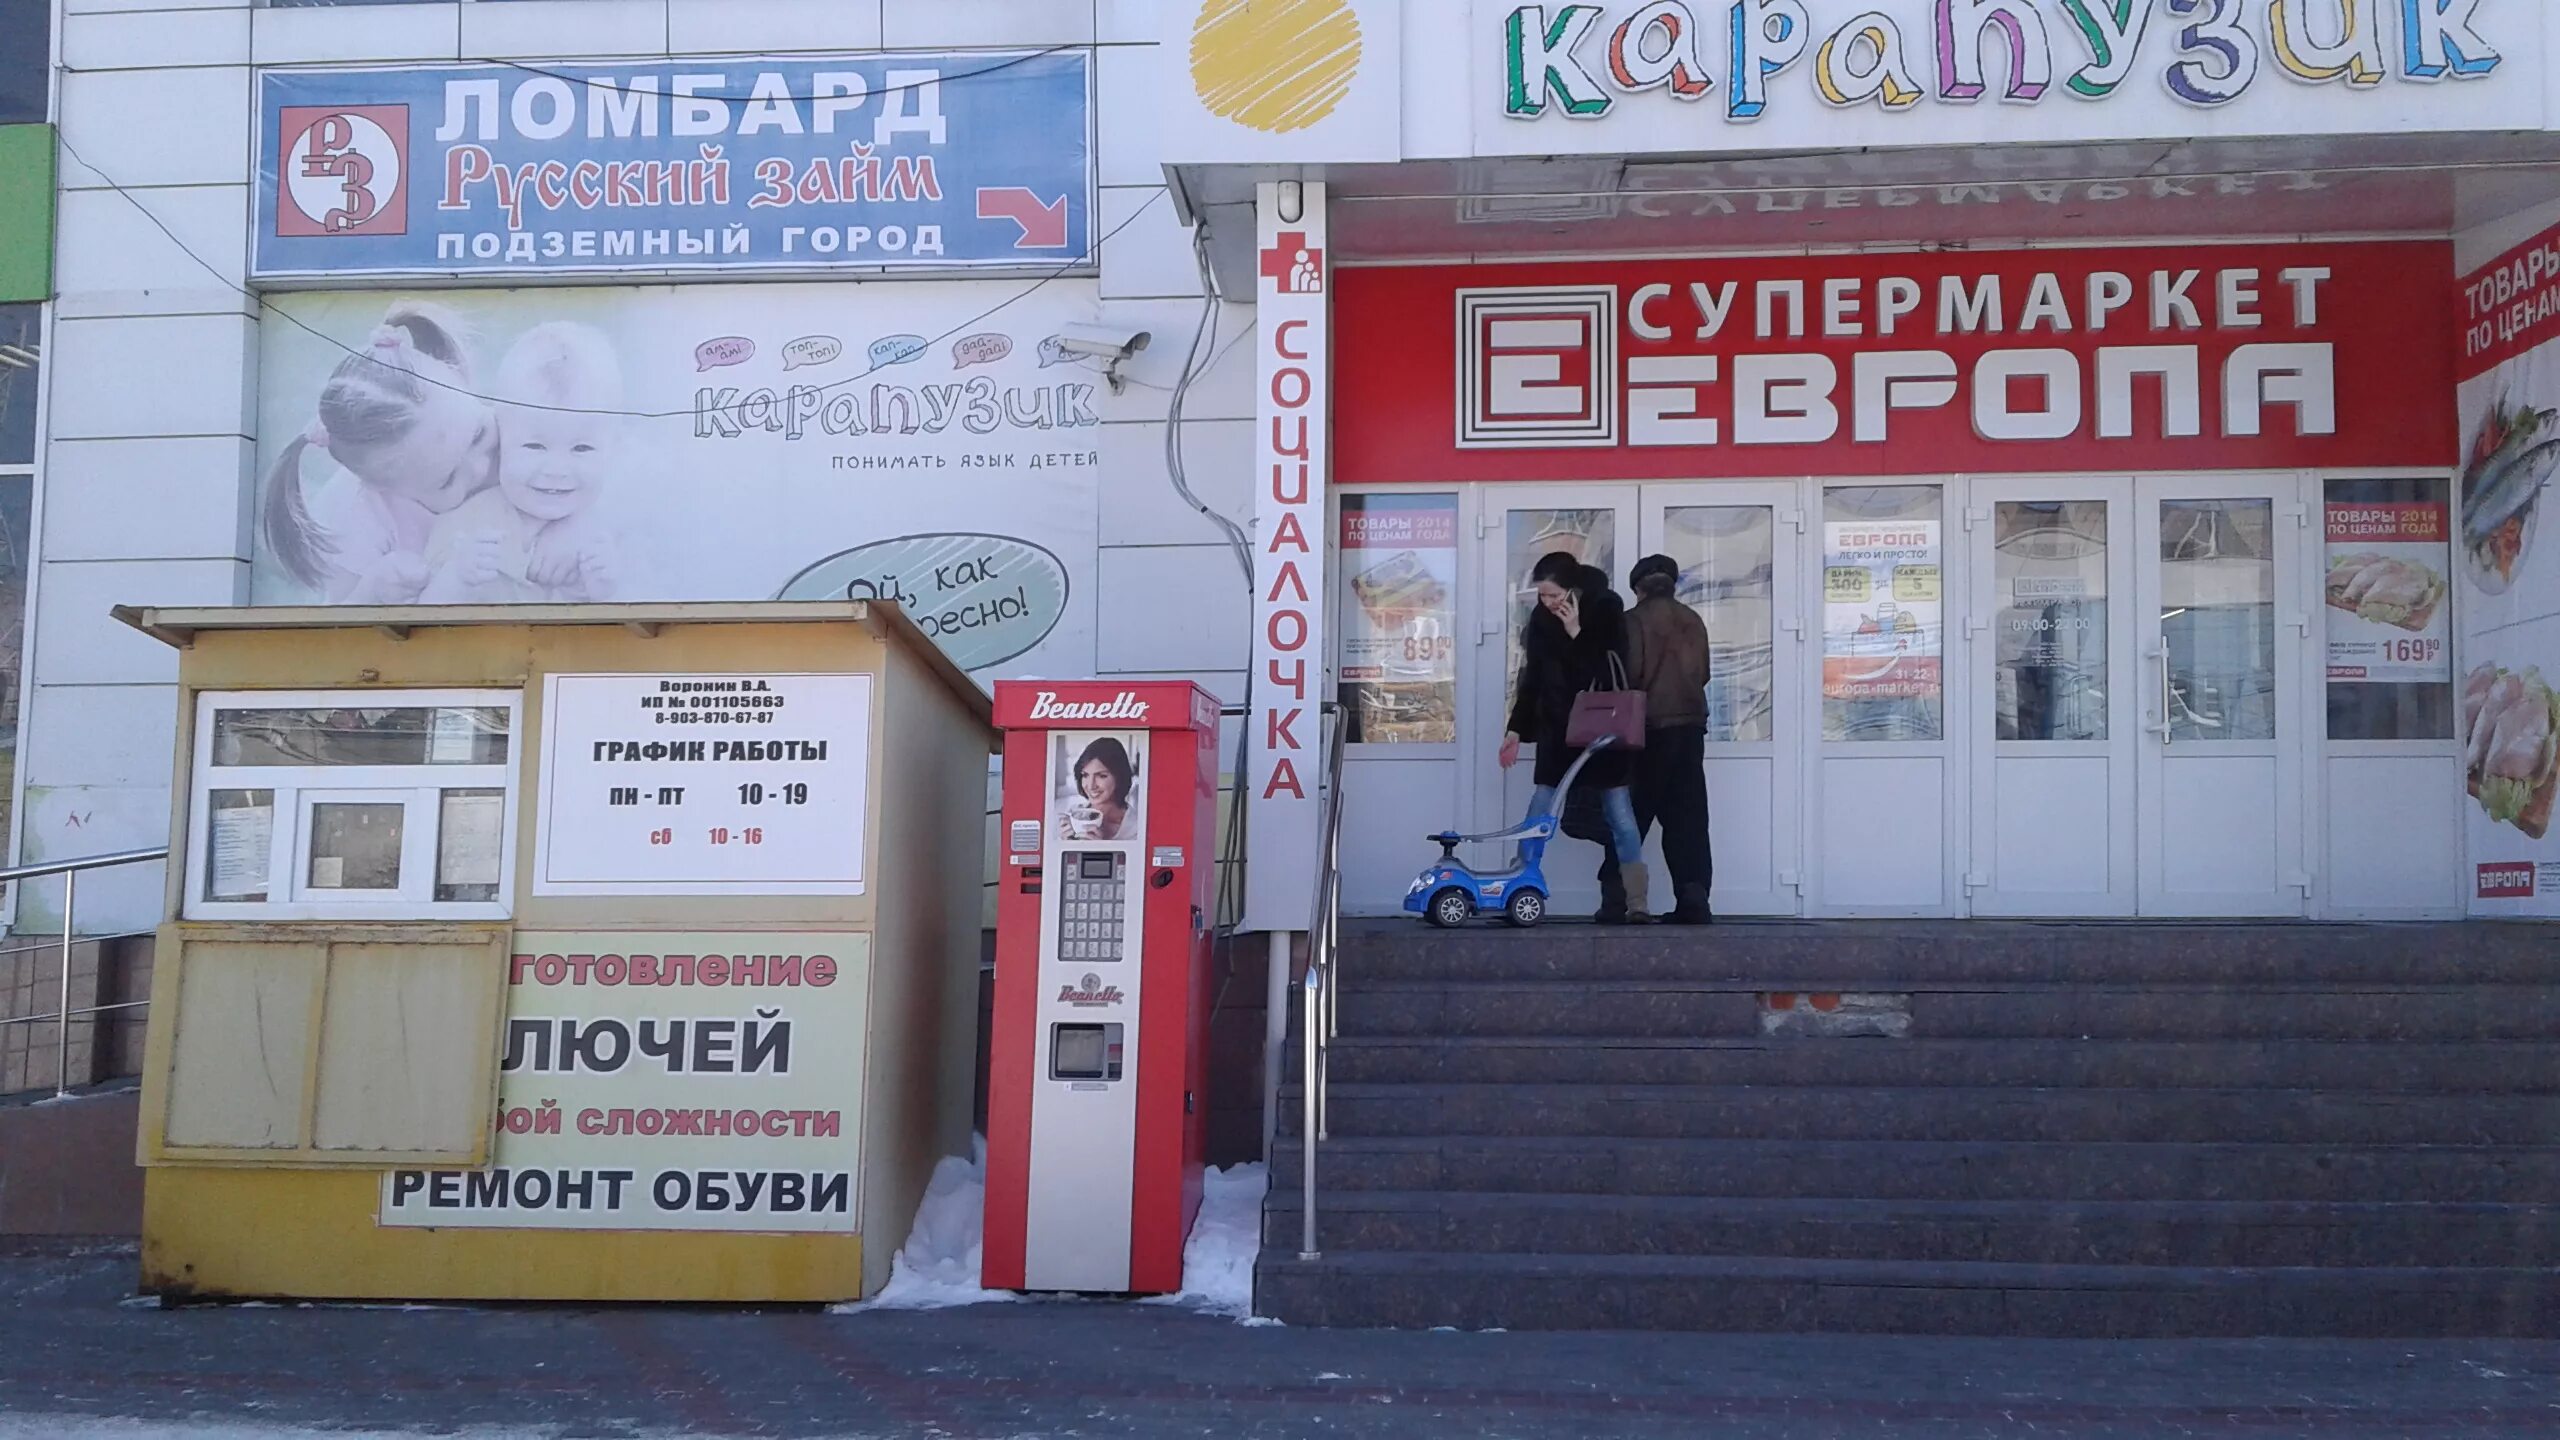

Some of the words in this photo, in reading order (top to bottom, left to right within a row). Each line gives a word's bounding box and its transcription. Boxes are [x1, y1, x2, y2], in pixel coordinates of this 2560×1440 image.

[436, 69, 947, 145] ЛОМБАРД
[438, 142, 731, 230] Русский
[746, 141, 944, 209] займ
[436, 224, 750, 261] ПОДЗЕМНЫЙ
[781, 225, 945, 255] ГОРОД
[1628, 267, 2331, 341] СУПЕРМАРКЕТ
[2467, 320, 2492, 357] ПО
[1628, 342, 2335, 446] ЕВРОПА
[832, 456, 946, 470] ПОНИМАТЬ
[961, 454, 1015, 468] ЯЗЫК
[1030, 451, 1098, 469] ДЕТЕЙ
[1348, 518, 1411, 529] ТОВАРЫ
[2327, 510, 2395, 523] ТОВАРЫ
[2401, 510, 2438, 522] 2014
[1348, 531, 1366, 541] ПО
[1368, 530, 1412, 541] ЦЕНАМ
[1416, 530, 1450, 541] ГОДА
[1839, 533, 1927, 547] ЕВРОПА
[2328, 524, 2346, 535] ПО
[2350, 524, 2396, 535] ЦЕНАМ
[2401, 523, 2438, 534] ГОДА
[1262, 319, 1311, 800] СОЦИАЛОЧКА
[934, 556, 998, 591] как
[2382, 639, 2424, 661] 169
[660, 681, 737, 693] Воронин
[741, 680, 771, 692] В.А.
[641, 696, 663, 708] ИП
[668, 696, 685, 708] №
[690, 696, 784, 708] 001105663
[655, 712, 773, 724] 8-903-870-67-87
[593, 741, 705, 762] ГРАФИК
[713, 740, 827, 761] РАБОТЫ
[738, 783, 763, 805] 10
[782, 783, 808, 805] 19
[650, 828, 672, 845] сб
[709, 828, 728, 845] 10
[743, 828, 762, 845] 16
[501, 1008, 791, 1073] ЛЮЧЕЙ
[577, 1107, 841, 1138] сложности
[392, 1168, 632, 1211] РЕМОНТ
[653, 1171, 849, 1212] ОБУВИ
